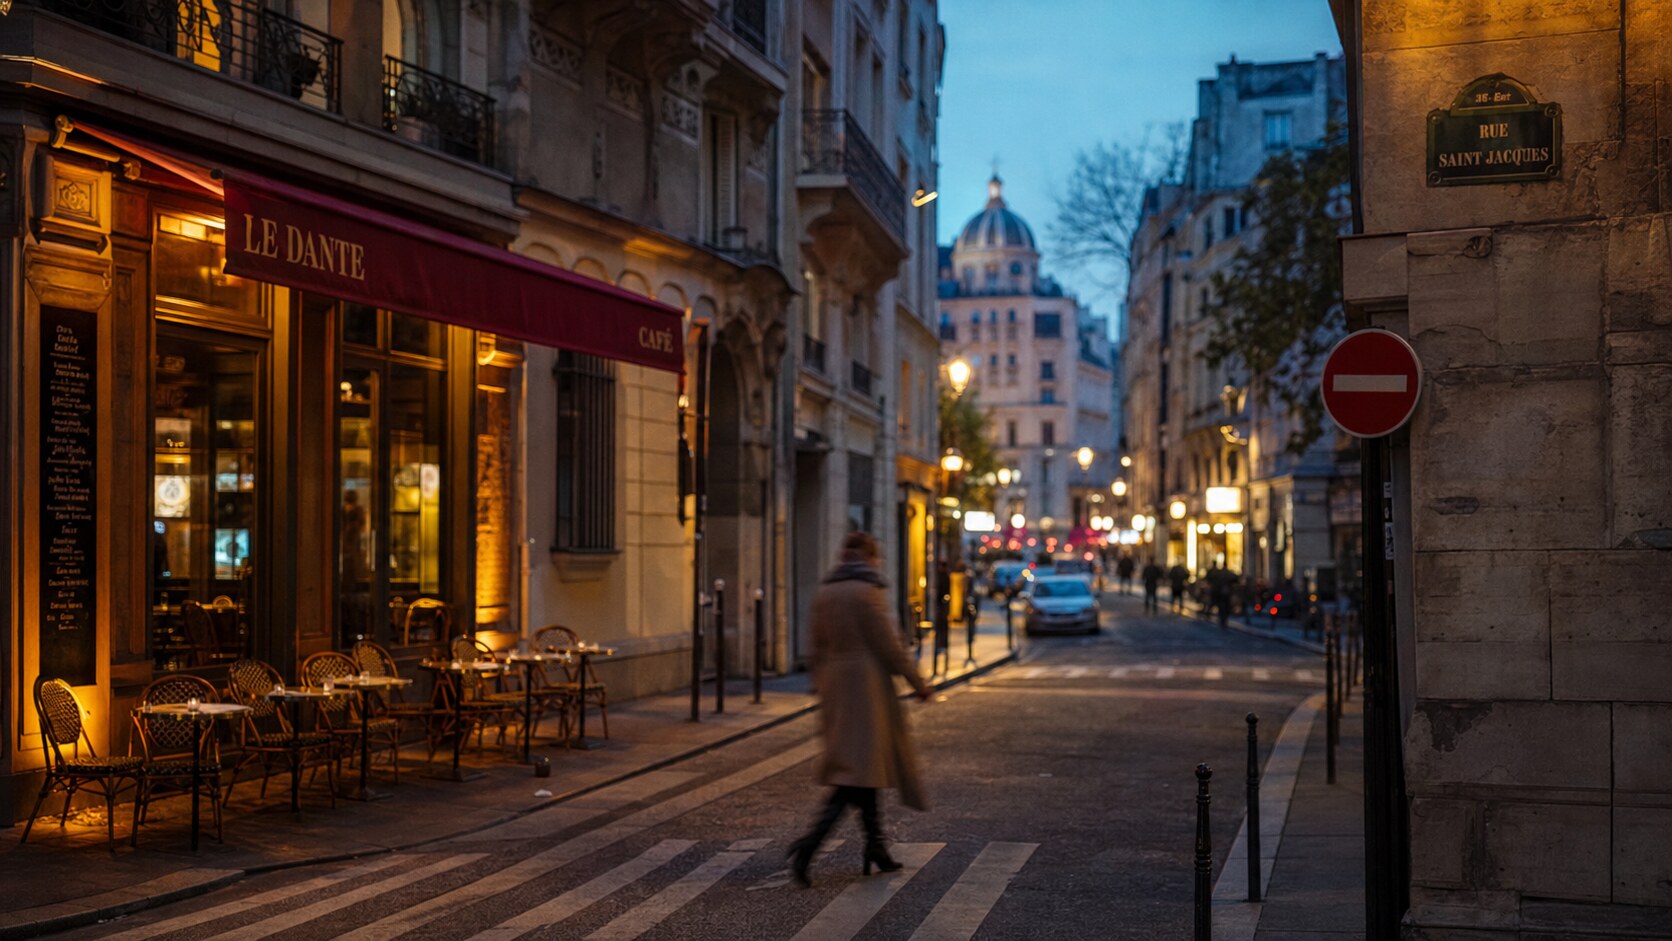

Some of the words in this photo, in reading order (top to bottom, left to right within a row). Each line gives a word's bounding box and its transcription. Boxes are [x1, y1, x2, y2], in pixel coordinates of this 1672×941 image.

[1480, 123, 1508, 138] RUE
[1439, 151, 1482, 167] SAINT
[1485, 147, 1549, 165] JACQUES
[243, 213, 278, 259] LE
[286, 224, 365, 281] DANTE
[639, 326, 673, 353] CAFÉ
